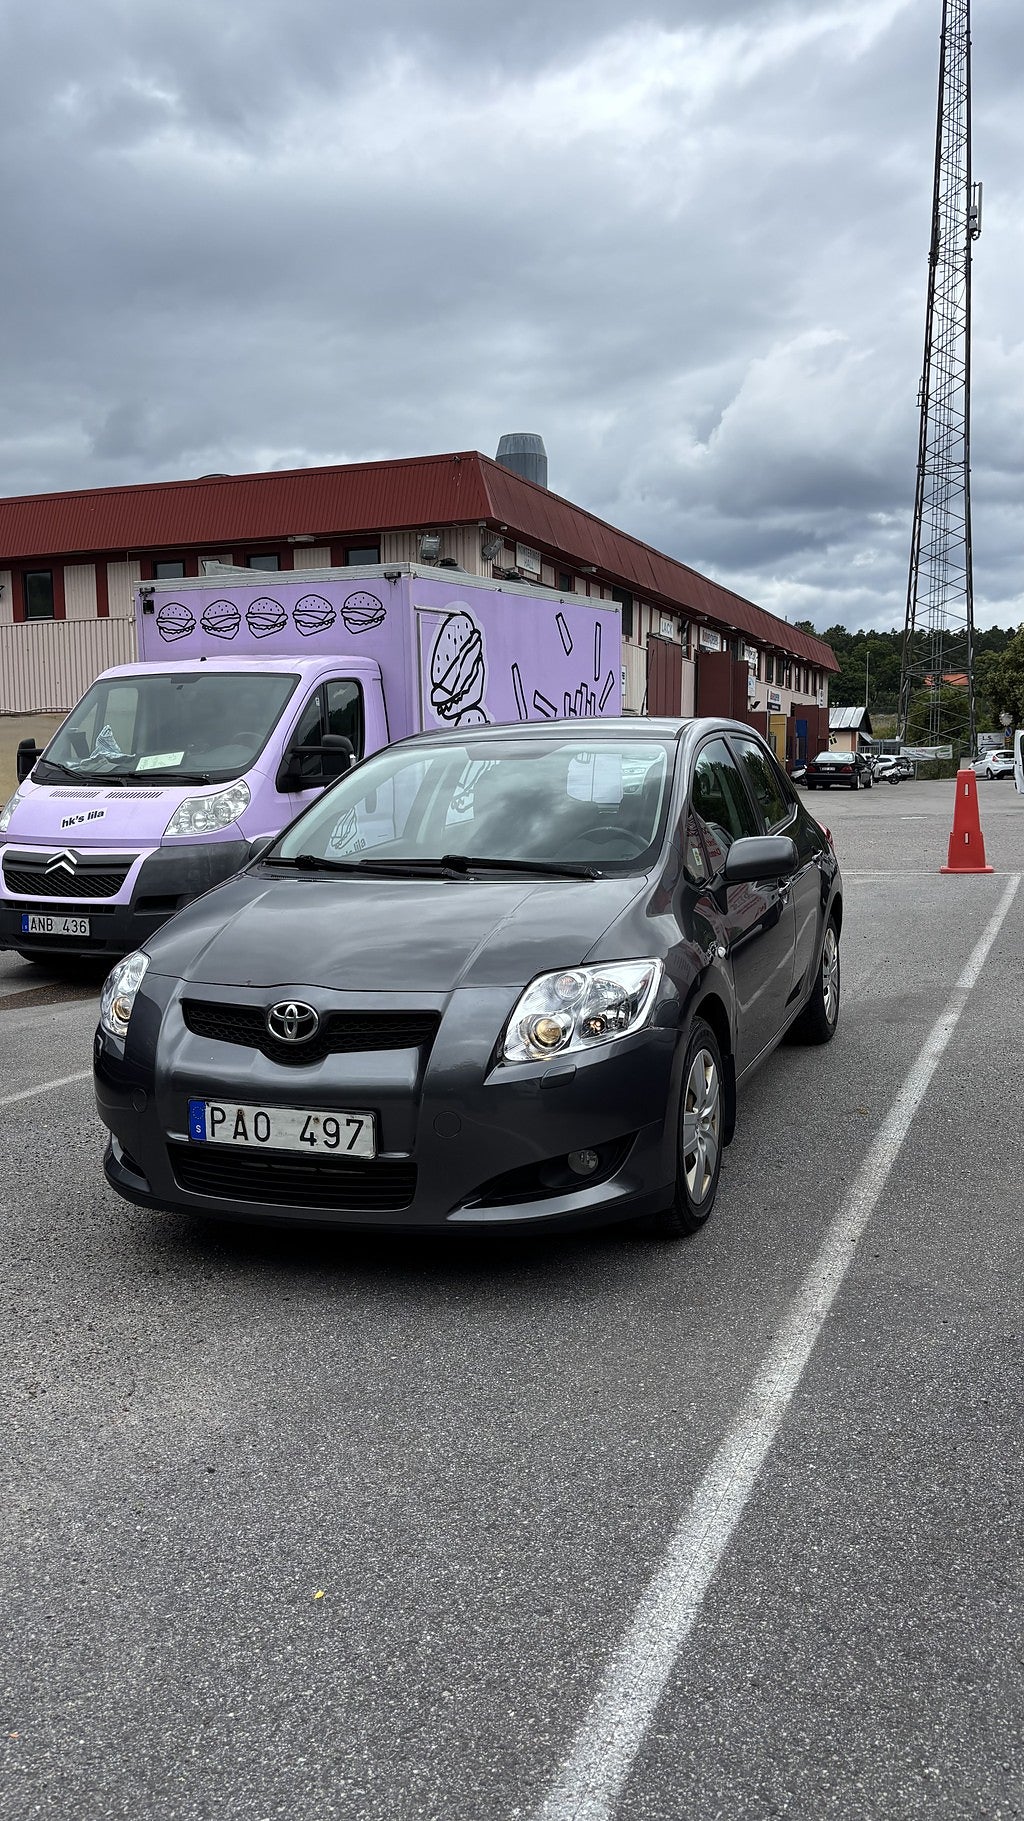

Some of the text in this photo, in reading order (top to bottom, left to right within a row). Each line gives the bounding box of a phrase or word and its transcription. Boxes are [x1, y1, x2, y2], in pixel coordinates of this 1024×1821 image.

[61, 810, 105, 828] hk's lila
[30, 917, 87, 934] ANB 436
[195, 1124, 202, 1134] S
[210, 1106, 365, 1151] PAO 497
